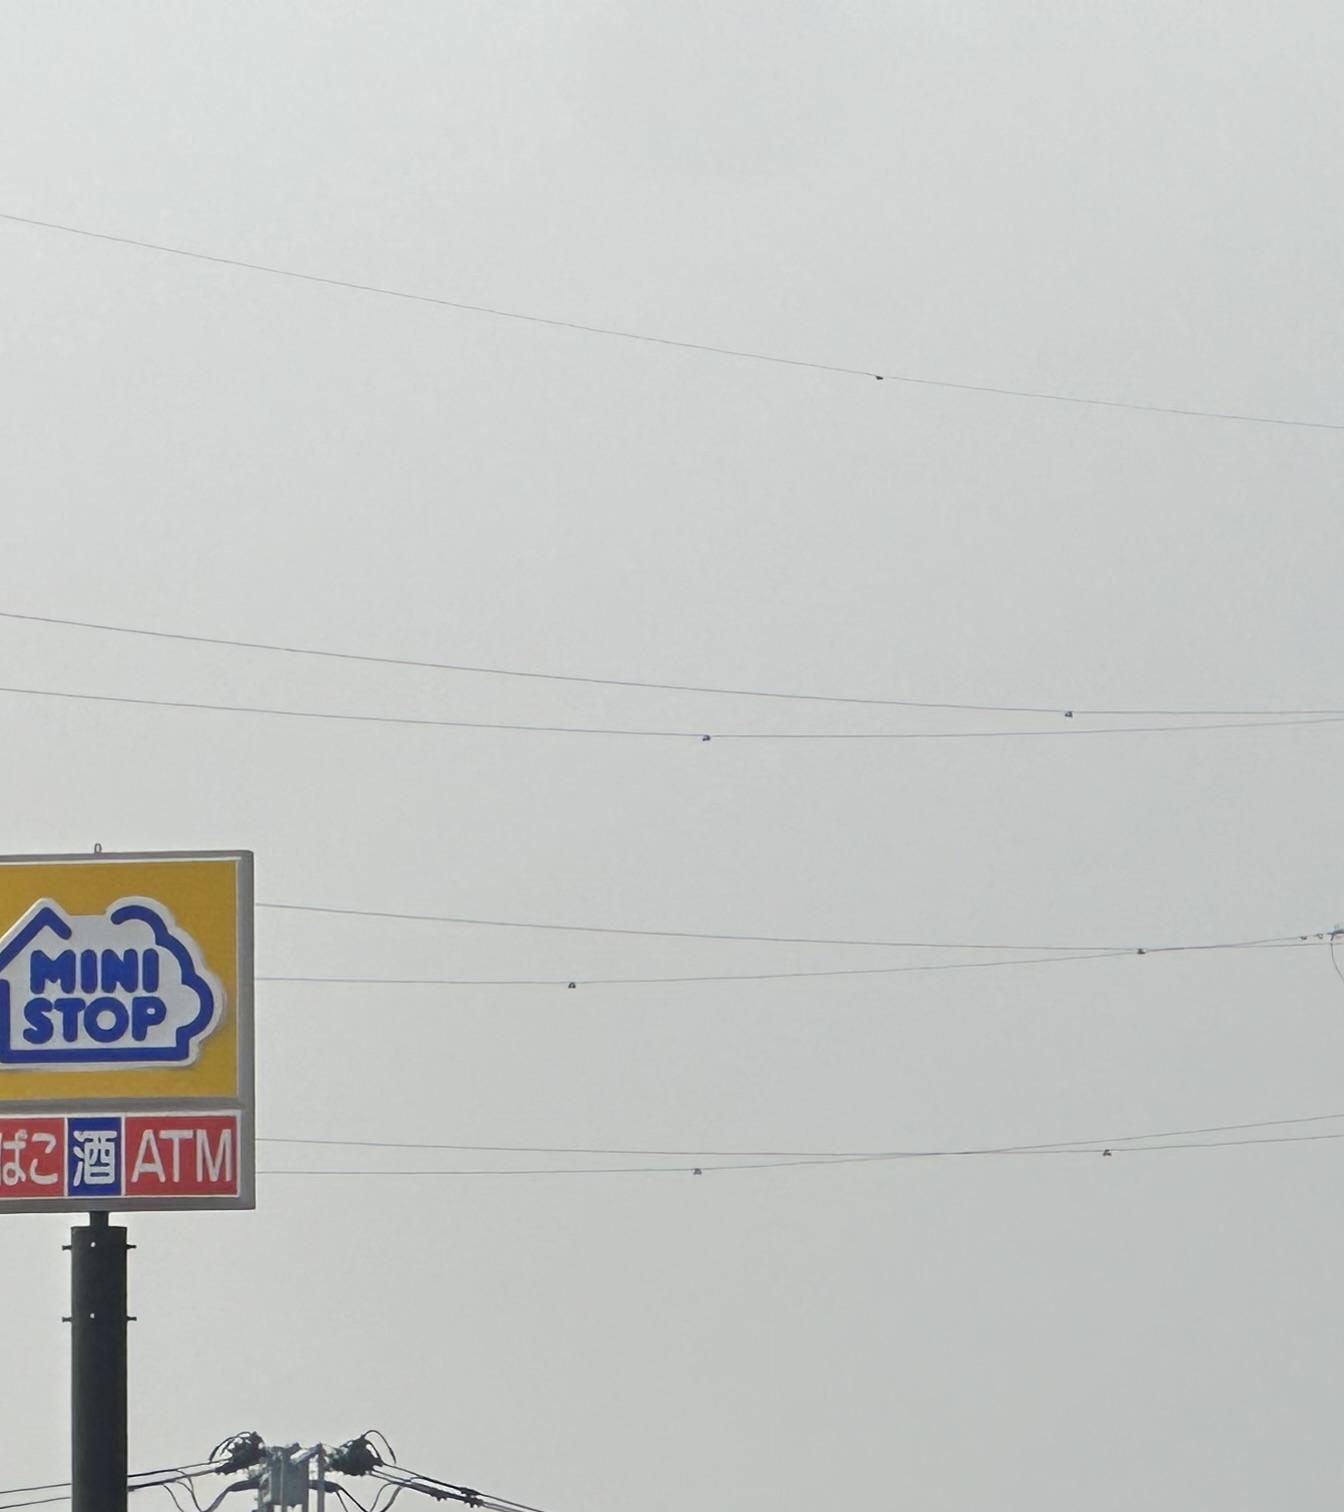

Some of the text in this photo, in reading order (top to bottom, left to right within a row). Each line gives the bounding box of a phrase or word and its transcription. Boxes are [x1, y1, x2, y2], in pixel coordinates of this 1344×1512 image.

[29, 947, 160, 995] MINI
[23, 996, 167, 1045] STOP
[73, 1129, 117, 1186] 酒
[130, 1128, 232, 1183] ATM
